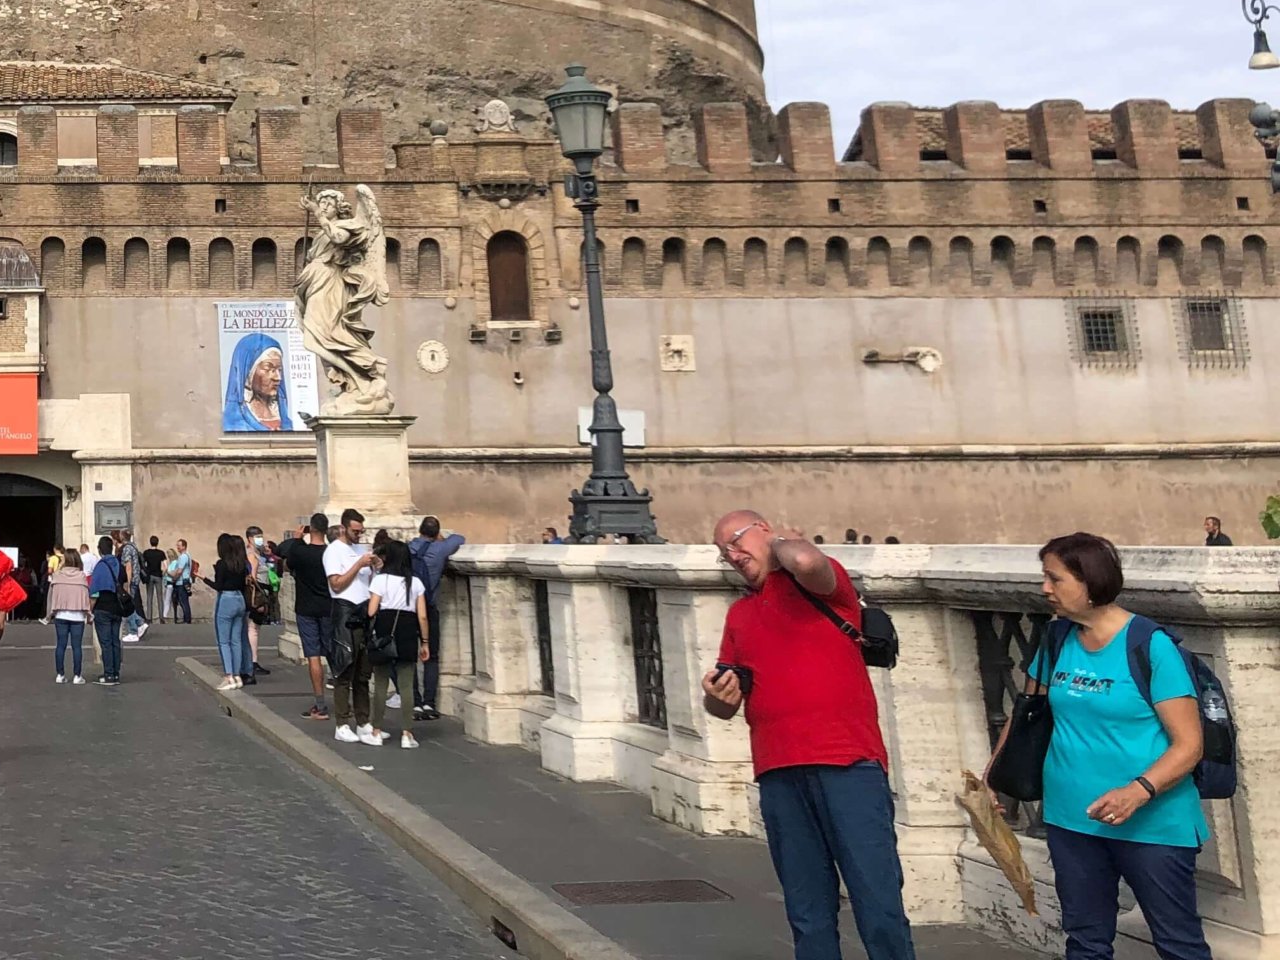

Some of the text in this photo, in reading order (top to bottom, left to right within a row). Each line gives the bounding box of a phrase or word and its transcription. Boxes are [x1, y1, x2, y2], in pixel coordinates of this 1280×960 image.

[223, 309, 297, 318] IL MONDO SALVE
[223, 317, 298, 329] LA BELLEZZ
[291, 371, 312, 380] 2021
